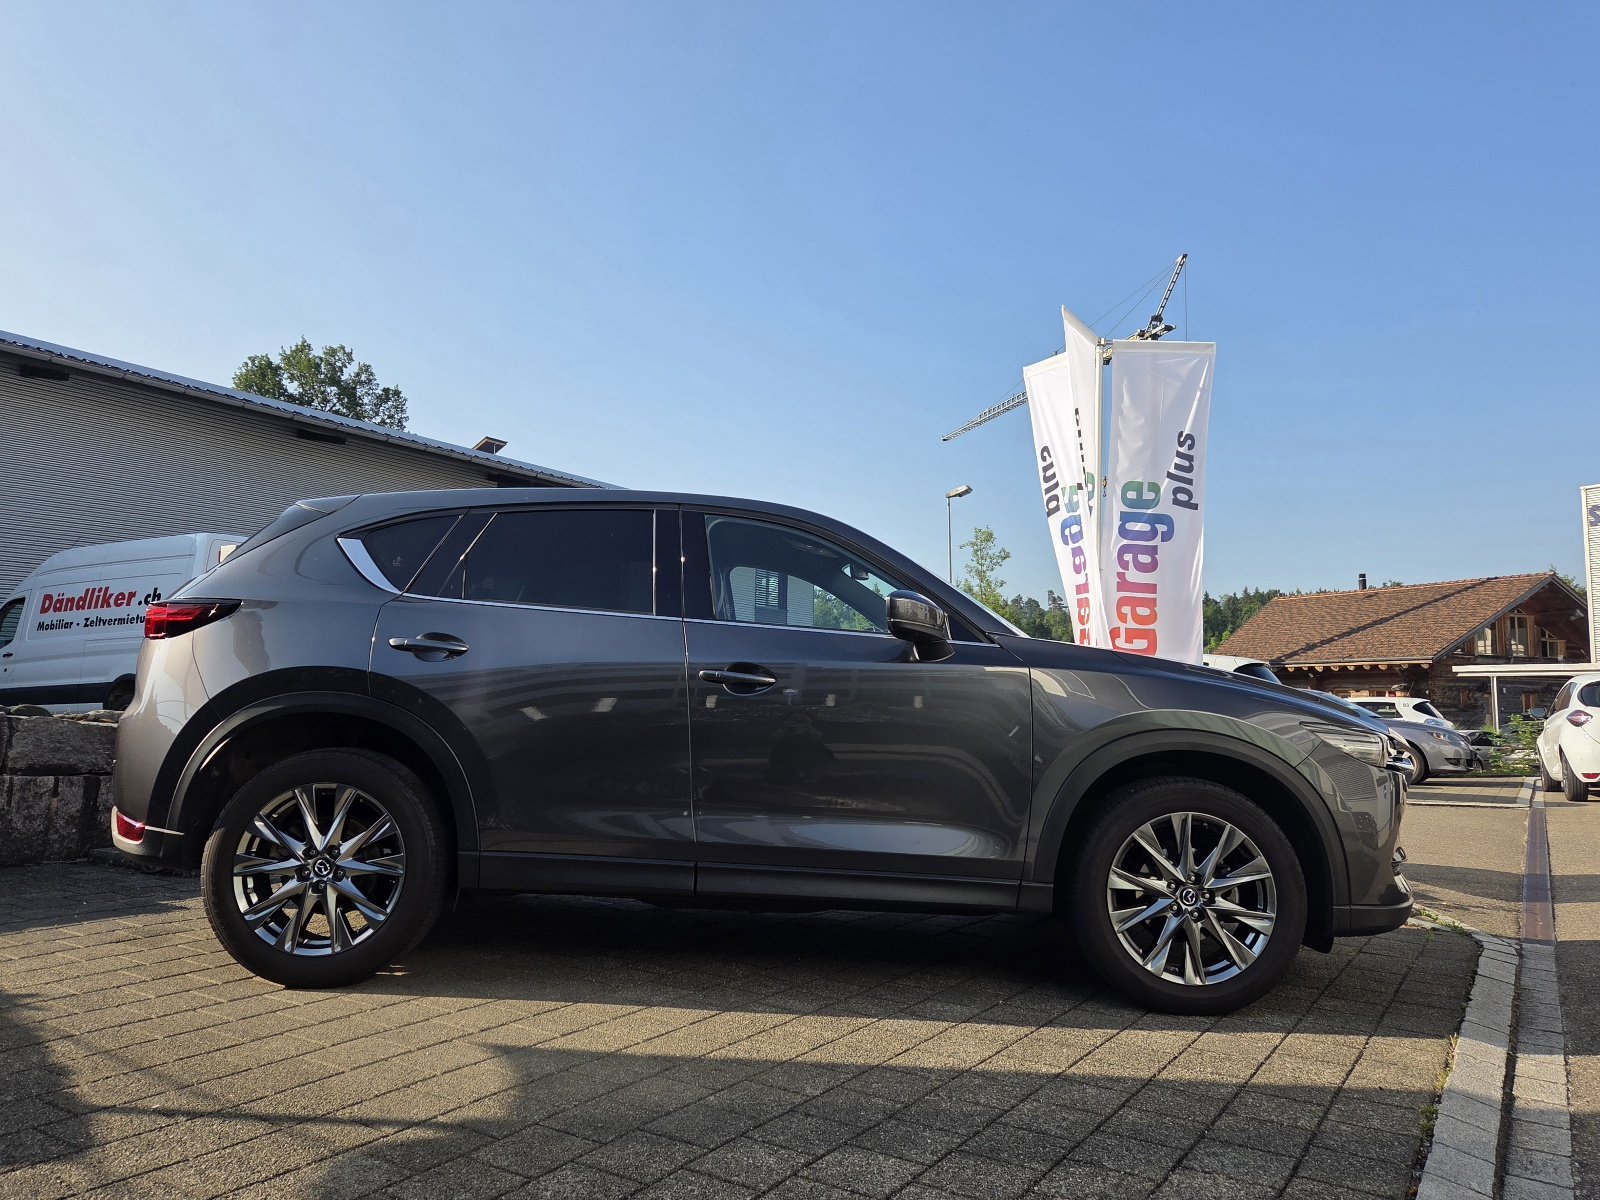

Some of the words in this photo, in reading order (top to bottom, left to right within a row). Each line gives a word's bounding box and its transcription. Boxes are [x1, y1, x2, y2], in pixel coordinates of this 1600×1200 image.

[1167, 430, 1199, 510] plus
[1109, 480, 1175, 657] Garage
[36, 618, 74, 632] Mobiliar
[83, 613, 146, 629] Zeltvermietu
